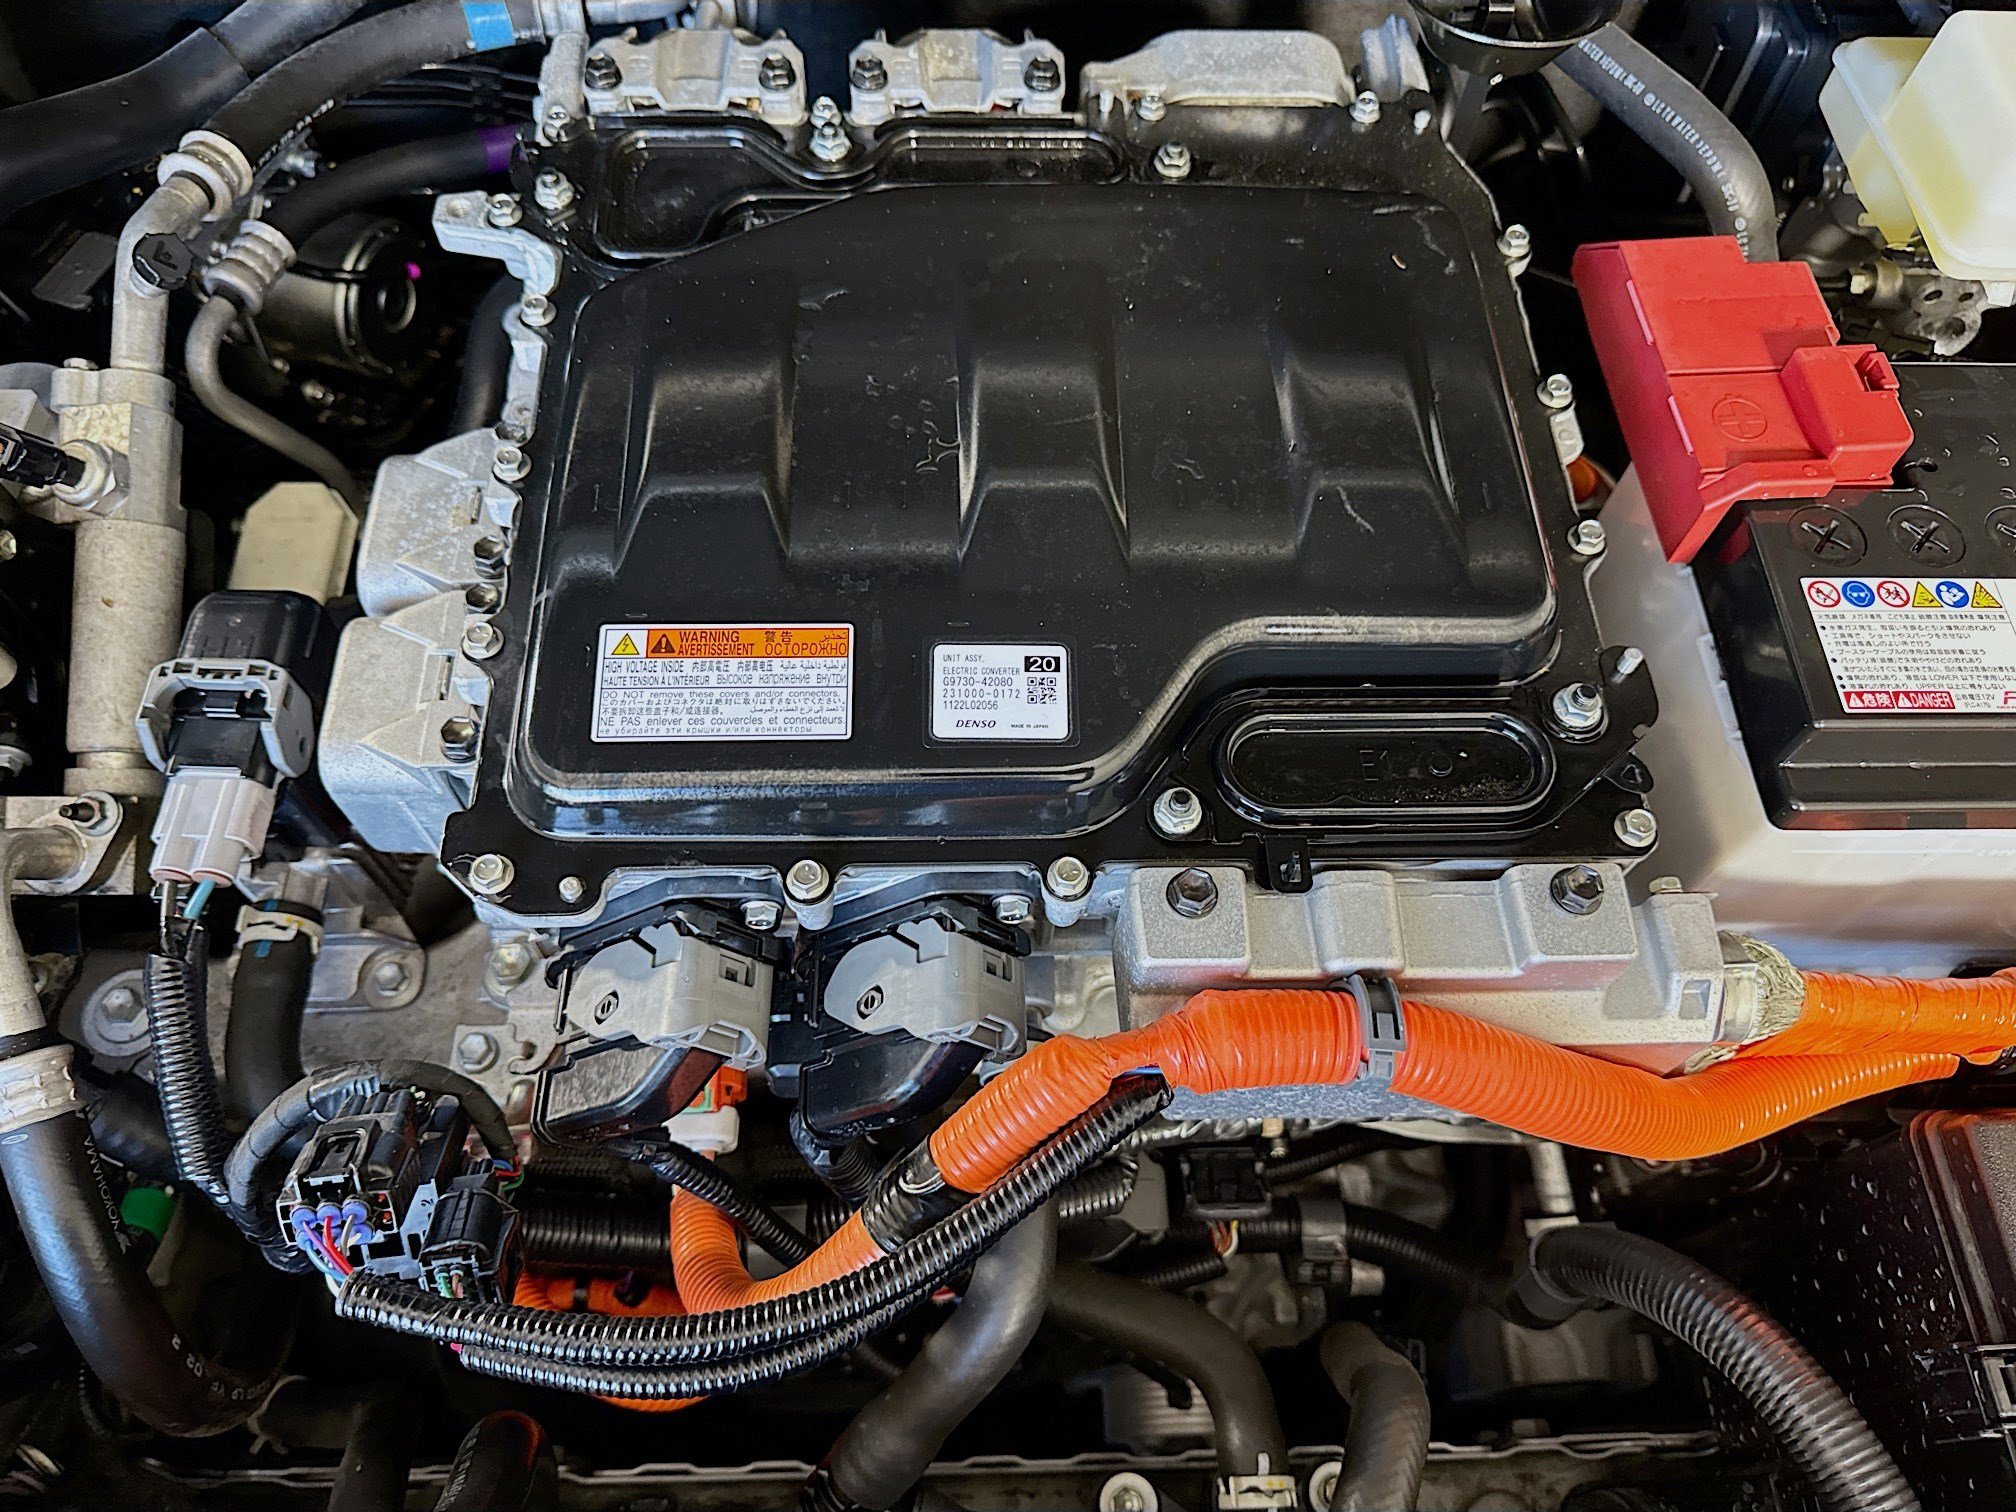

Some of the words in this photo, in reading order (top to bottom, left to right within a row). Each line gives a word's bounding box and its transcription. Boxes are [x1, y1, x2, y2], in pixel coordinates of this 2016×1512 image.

[1671, 114, 1700, 144] WATER
[679, 631, 740, 643] WARNING
[819, 630, 848, 643] تحذير
[677, 643, 755, 656] AVERTISSEMENT
[764, 642, 847, 656] ОСТОРОЖНО
[943, 654, 961, 662] UNIT
[605, 660, 622, 673] HIGH
[626, 660, 658, 673] VOLTAGE
[660, 660, 684, 673] INSIDE
[1029, 657, 1056, 672] 20
[943, 667, 978, 675] ELECTRIC
[981, 667, 1020, 676] CONVERTER
[603, 676, 627, 687] HAUTE
[629, 676, 659, 687] TENSION
[943, 677, 1013, 687] G9730-42080
[602, 691, 618, 699] DO
[623, 691, 645, 699] NOT
[649, 691, 684, 699] remove
[689, 690, 715, 698] these
[754, 689, 784, 698] and/or
[788, 690, 841, 698] connectors.
[943, 688, 1020, 699] 231000-0172
[943, 700, 999, 710] 1122L02056
[1862, 692, 1893, 707] 危険
[1909, 692, 1954, 708] DANGER
[600, 717, 616, 727] NE
[620, 717, 641, 726] PAS
[646, 716, 683, 726] enlever
[687, 718, 705, 726] ces
[710, 716, 763, 726] couvercles
[768, 716, 778, 725] et
[955, 719, 997, 728] DENSO
[686, 727, 721, 735] крышки
[84, 1135, 120, 1231] YOKOHAMA
